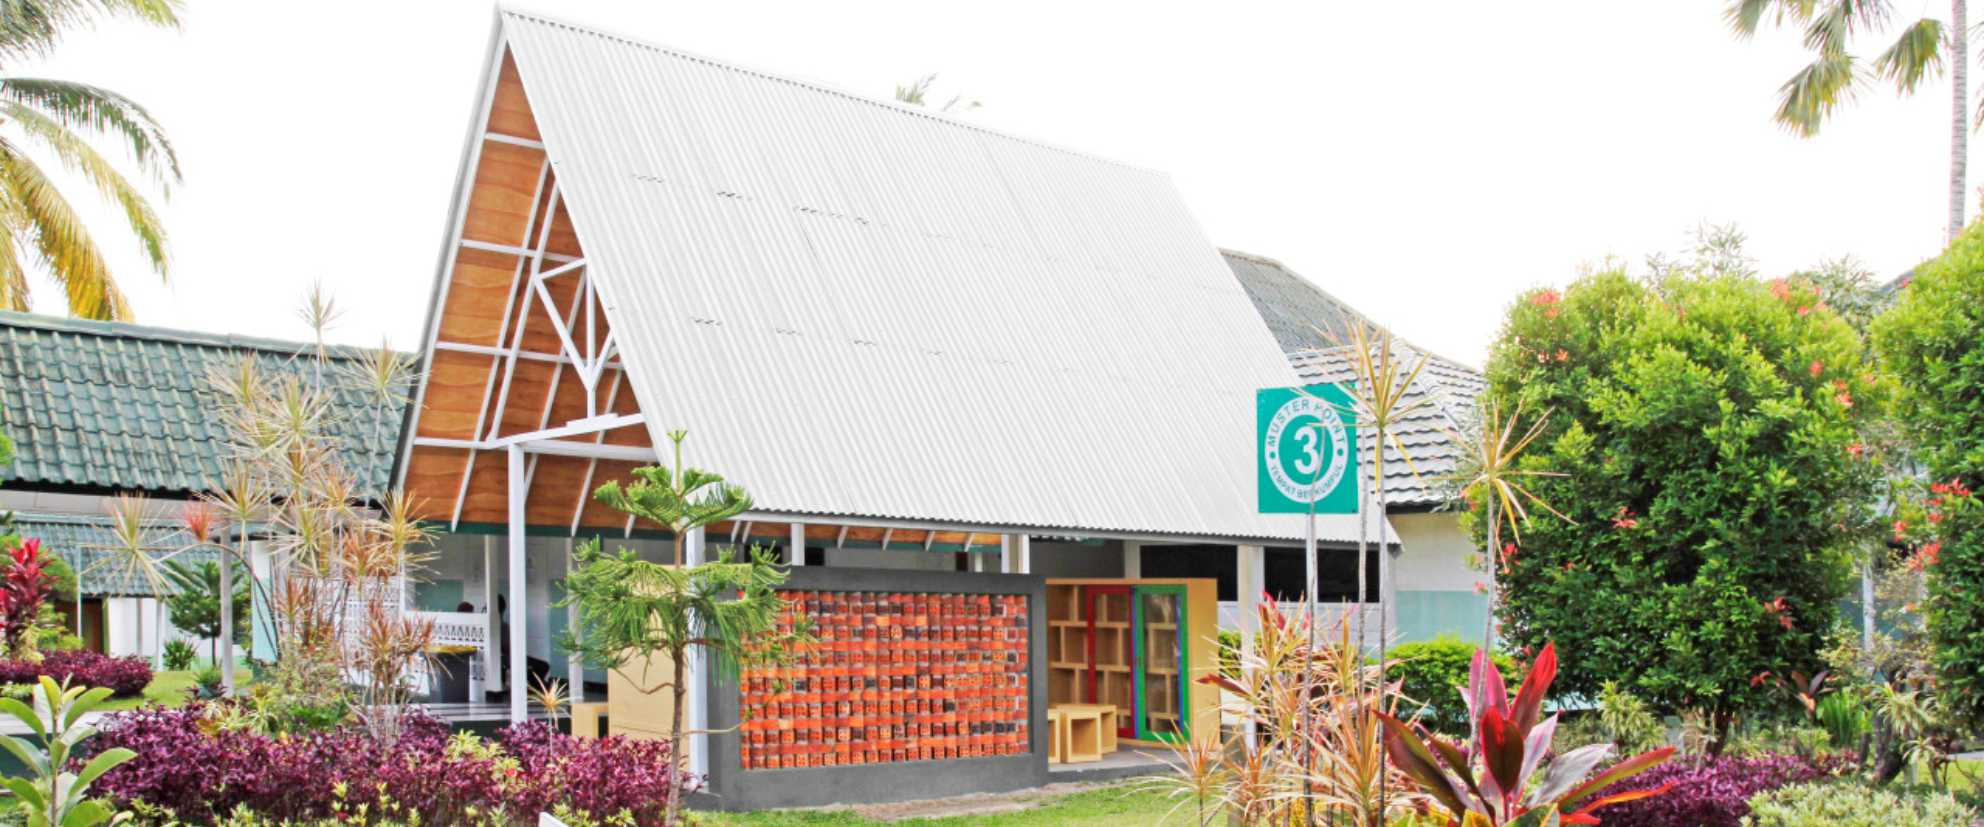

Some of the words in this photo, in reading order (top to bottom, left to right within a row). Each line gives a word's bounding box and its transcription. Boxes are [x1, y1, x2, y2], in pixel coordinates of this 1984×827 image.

[1268, 399, 1309, 447] MUSTER
[1312, 402, 1345, 442] POINT
[1294, 425, 1318, 474] 3
[1271, 464, 1296, 496] TEMPAT
